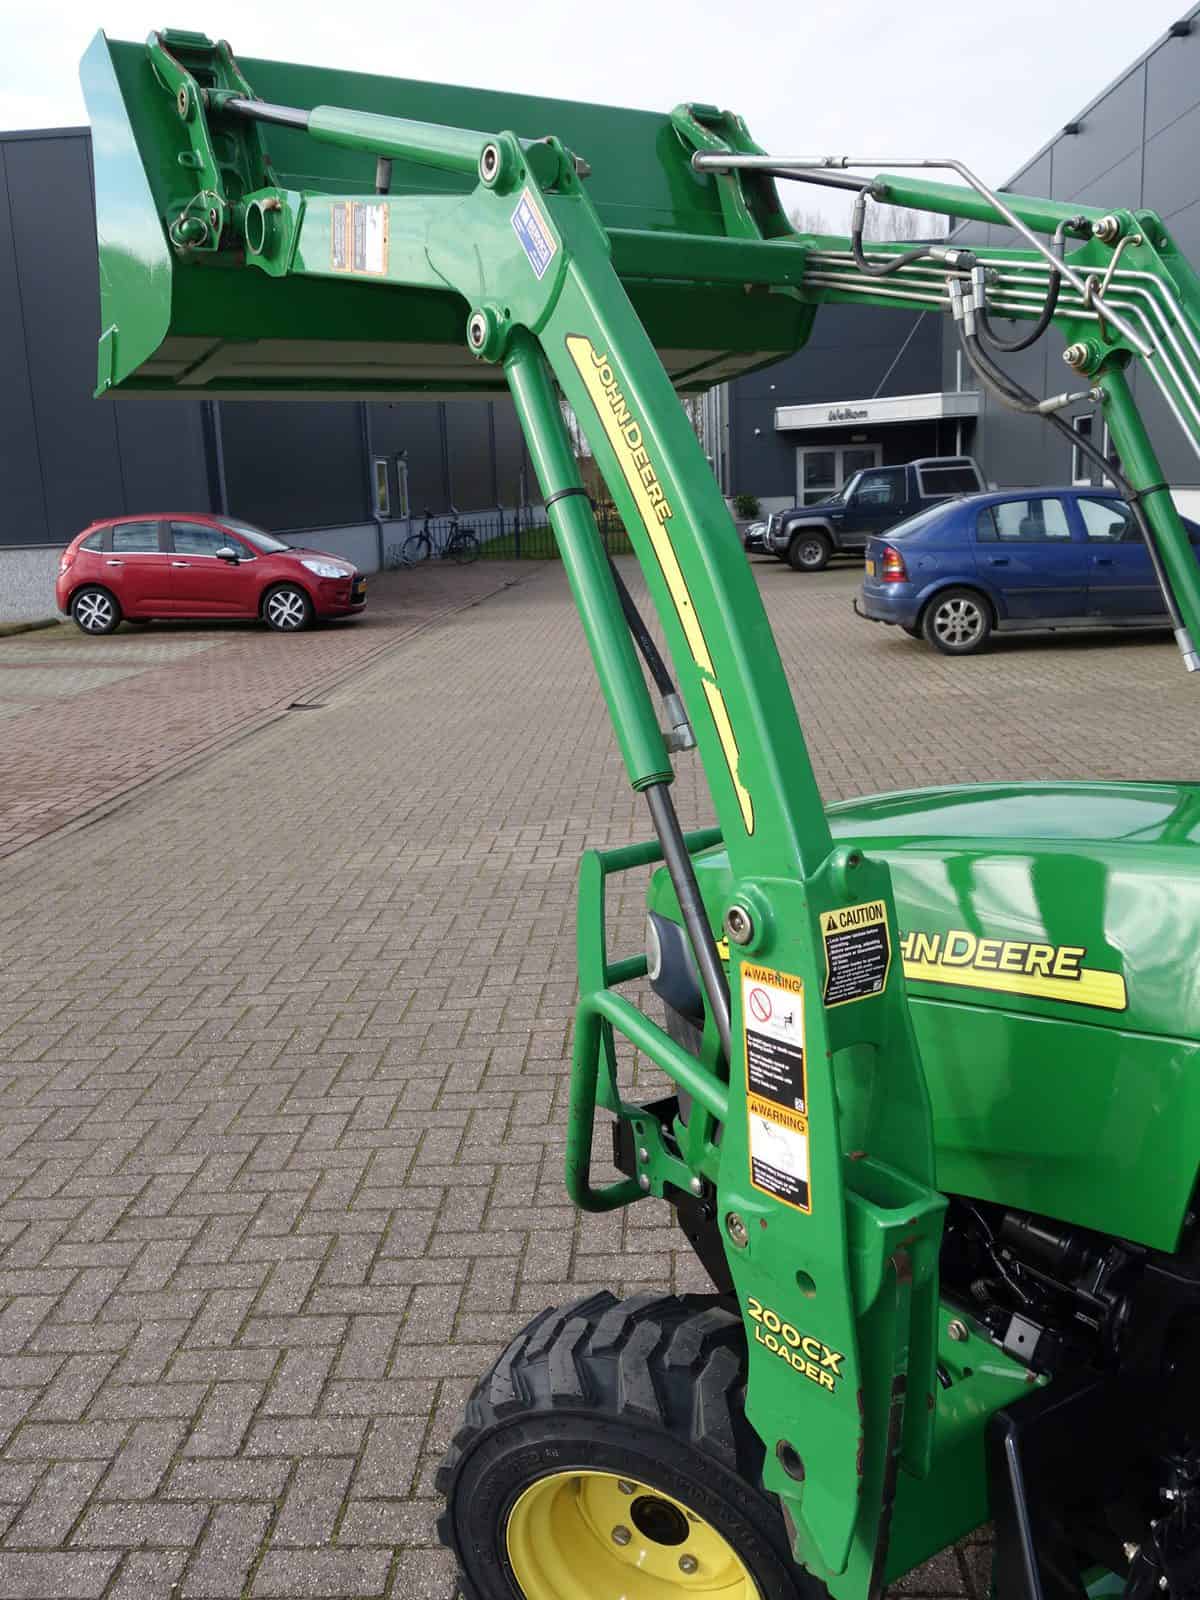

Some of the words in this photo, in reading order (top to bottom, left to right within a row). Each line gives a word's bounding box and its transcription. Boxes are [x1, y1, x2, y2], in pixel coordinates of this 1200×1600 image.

[839, 903, 883, 928] CAUTION
[942, 929, 1086, 980] DEERE
[753, 968, 801, 993] WARNING
[758, 1103, 805, 1132] WARNING
[747, 1296, 843, 1376] 200CX
[755, 1325, 835, 1392] LOADER
